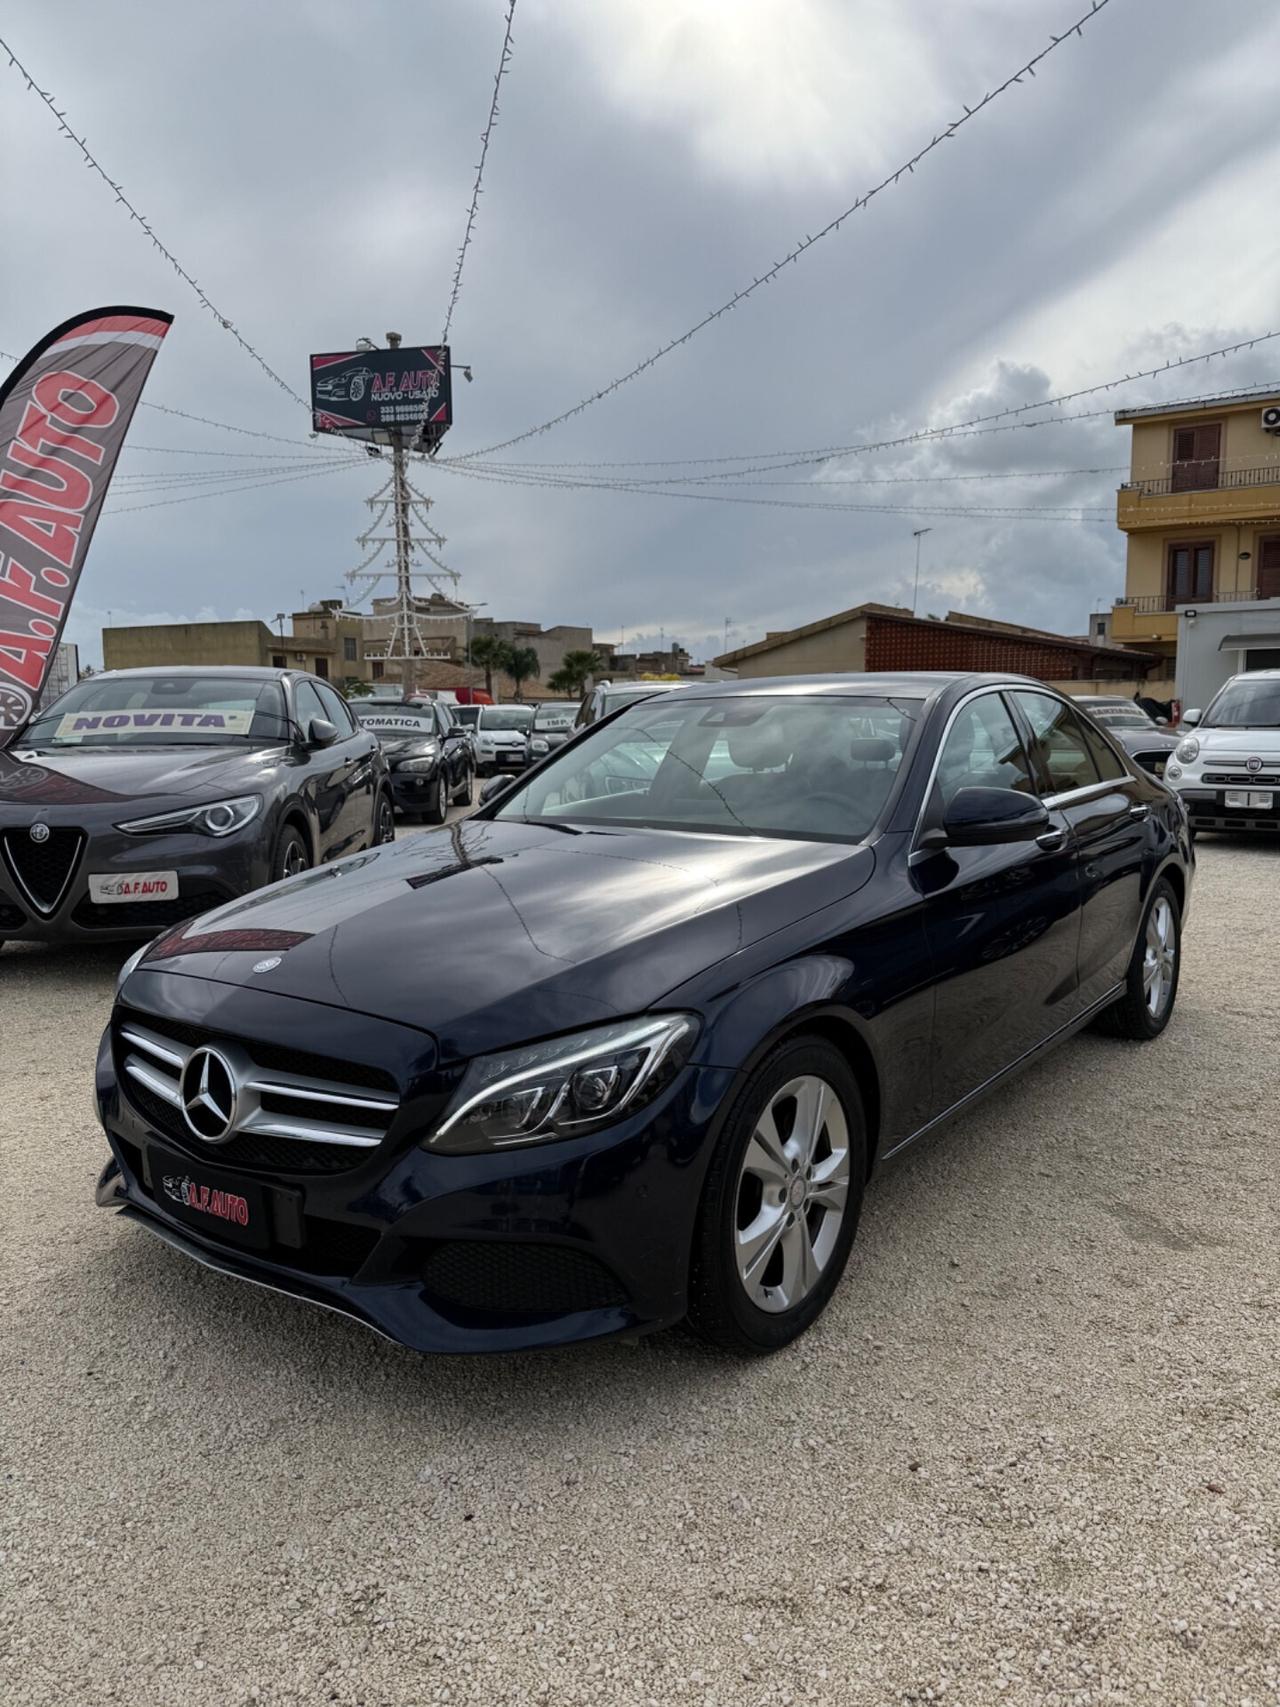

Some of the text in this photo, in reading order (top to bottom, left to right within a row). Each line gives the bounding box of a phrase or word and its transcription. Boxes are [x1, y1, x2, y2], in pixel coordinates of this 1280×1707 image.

[371, 370, 440, 392] A.F. AUTO
[371, 389, 439, 402] NUOVO USATO
[72, 713, 237, 731] NOVITA'
